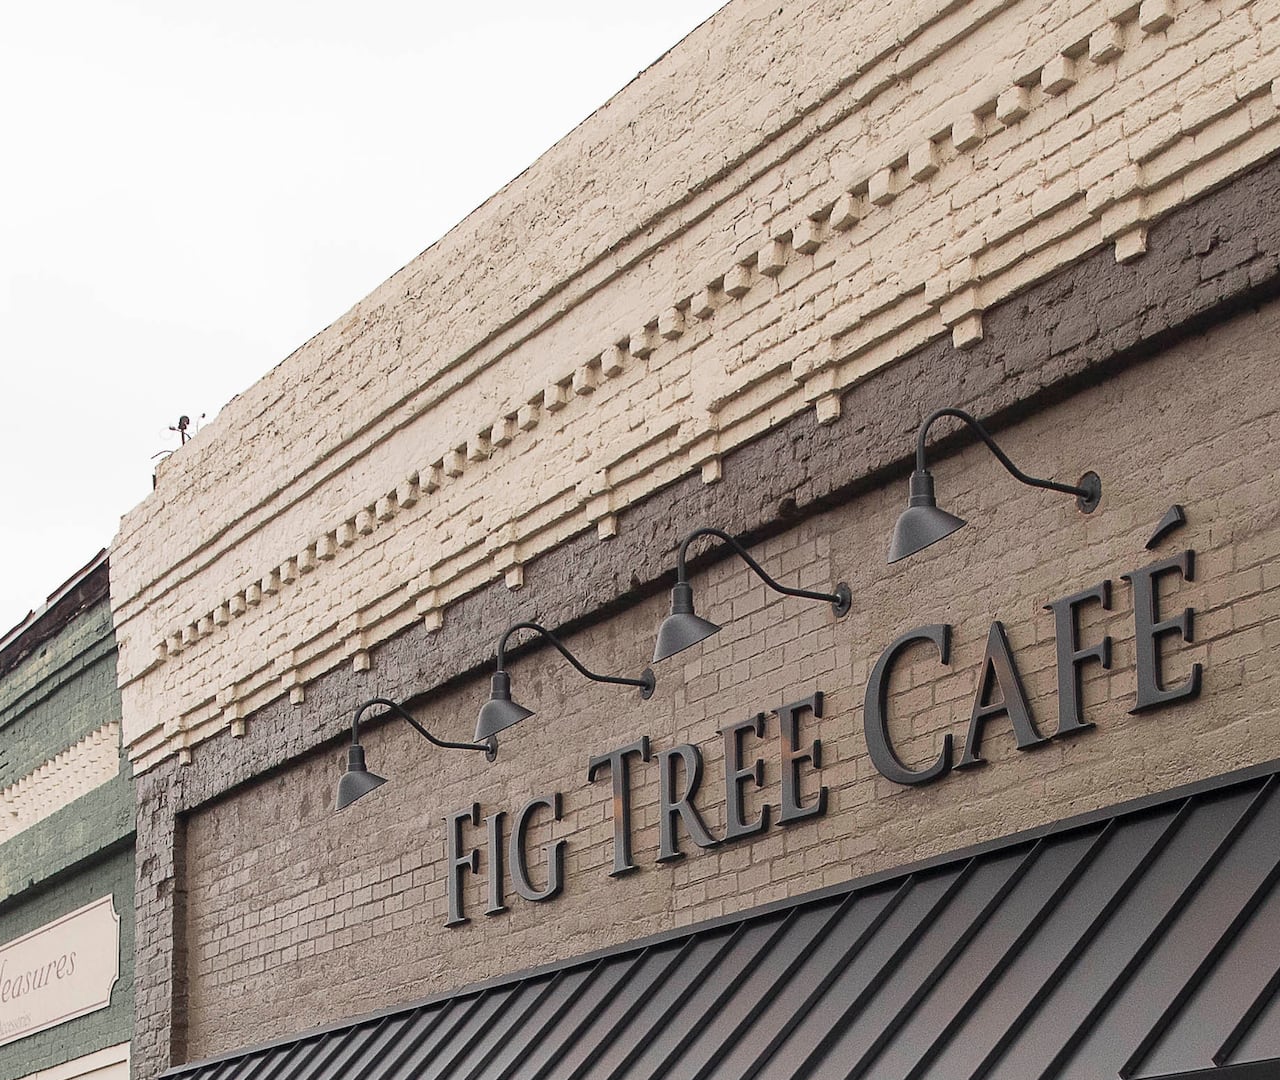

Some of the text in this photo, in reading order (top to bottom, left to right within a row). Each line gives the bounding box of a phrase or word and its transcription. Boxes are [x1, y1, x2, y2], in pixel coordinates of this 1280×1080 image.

[443, 504, 1204, 929] FIG TREE CAFÉ
